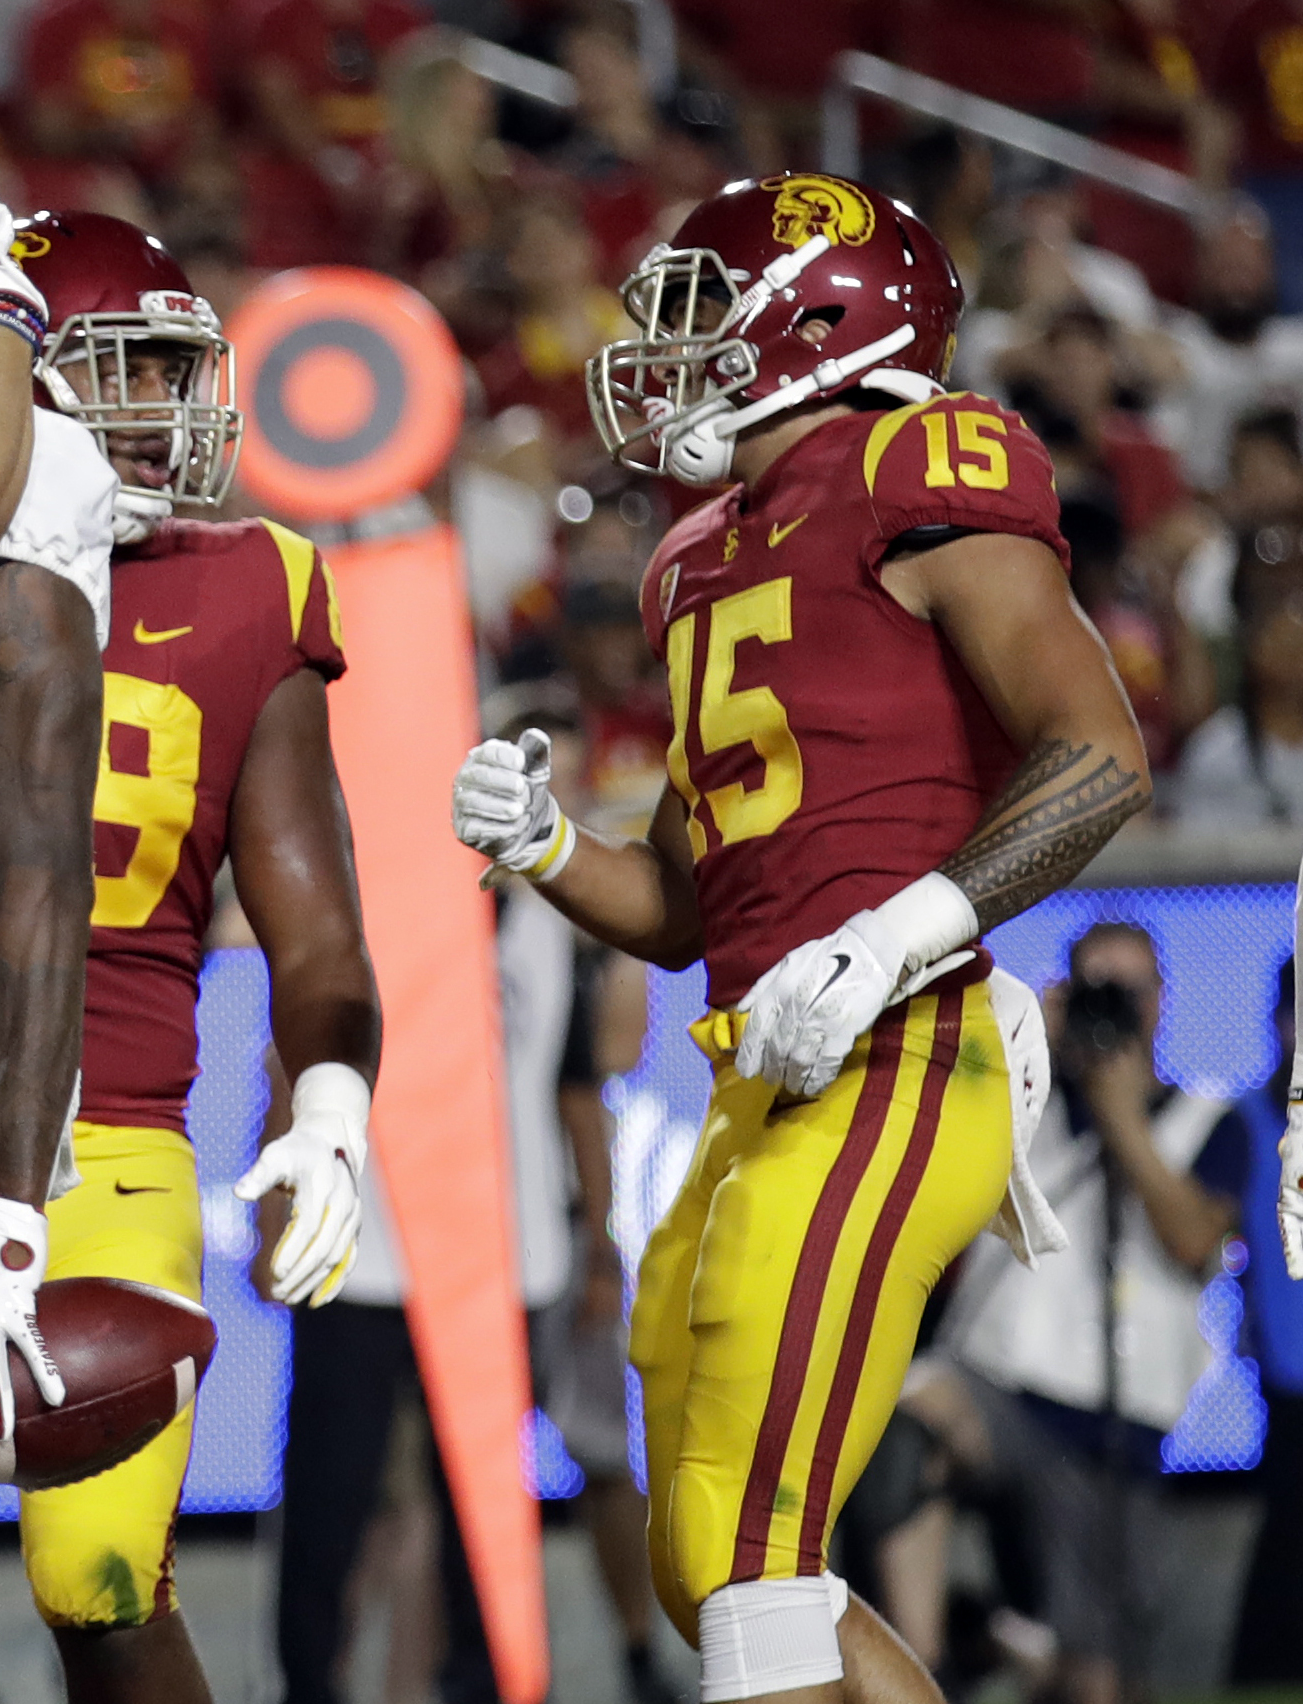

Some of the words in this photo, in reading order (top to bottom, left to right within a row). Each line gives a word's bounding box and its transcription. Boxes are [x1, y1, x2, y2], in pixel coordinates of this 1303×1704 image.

[921, 410, 1010, 490] 15
[666, 575, 803, 861] 15
[24, 1313, 60, 1376] STANFORD
